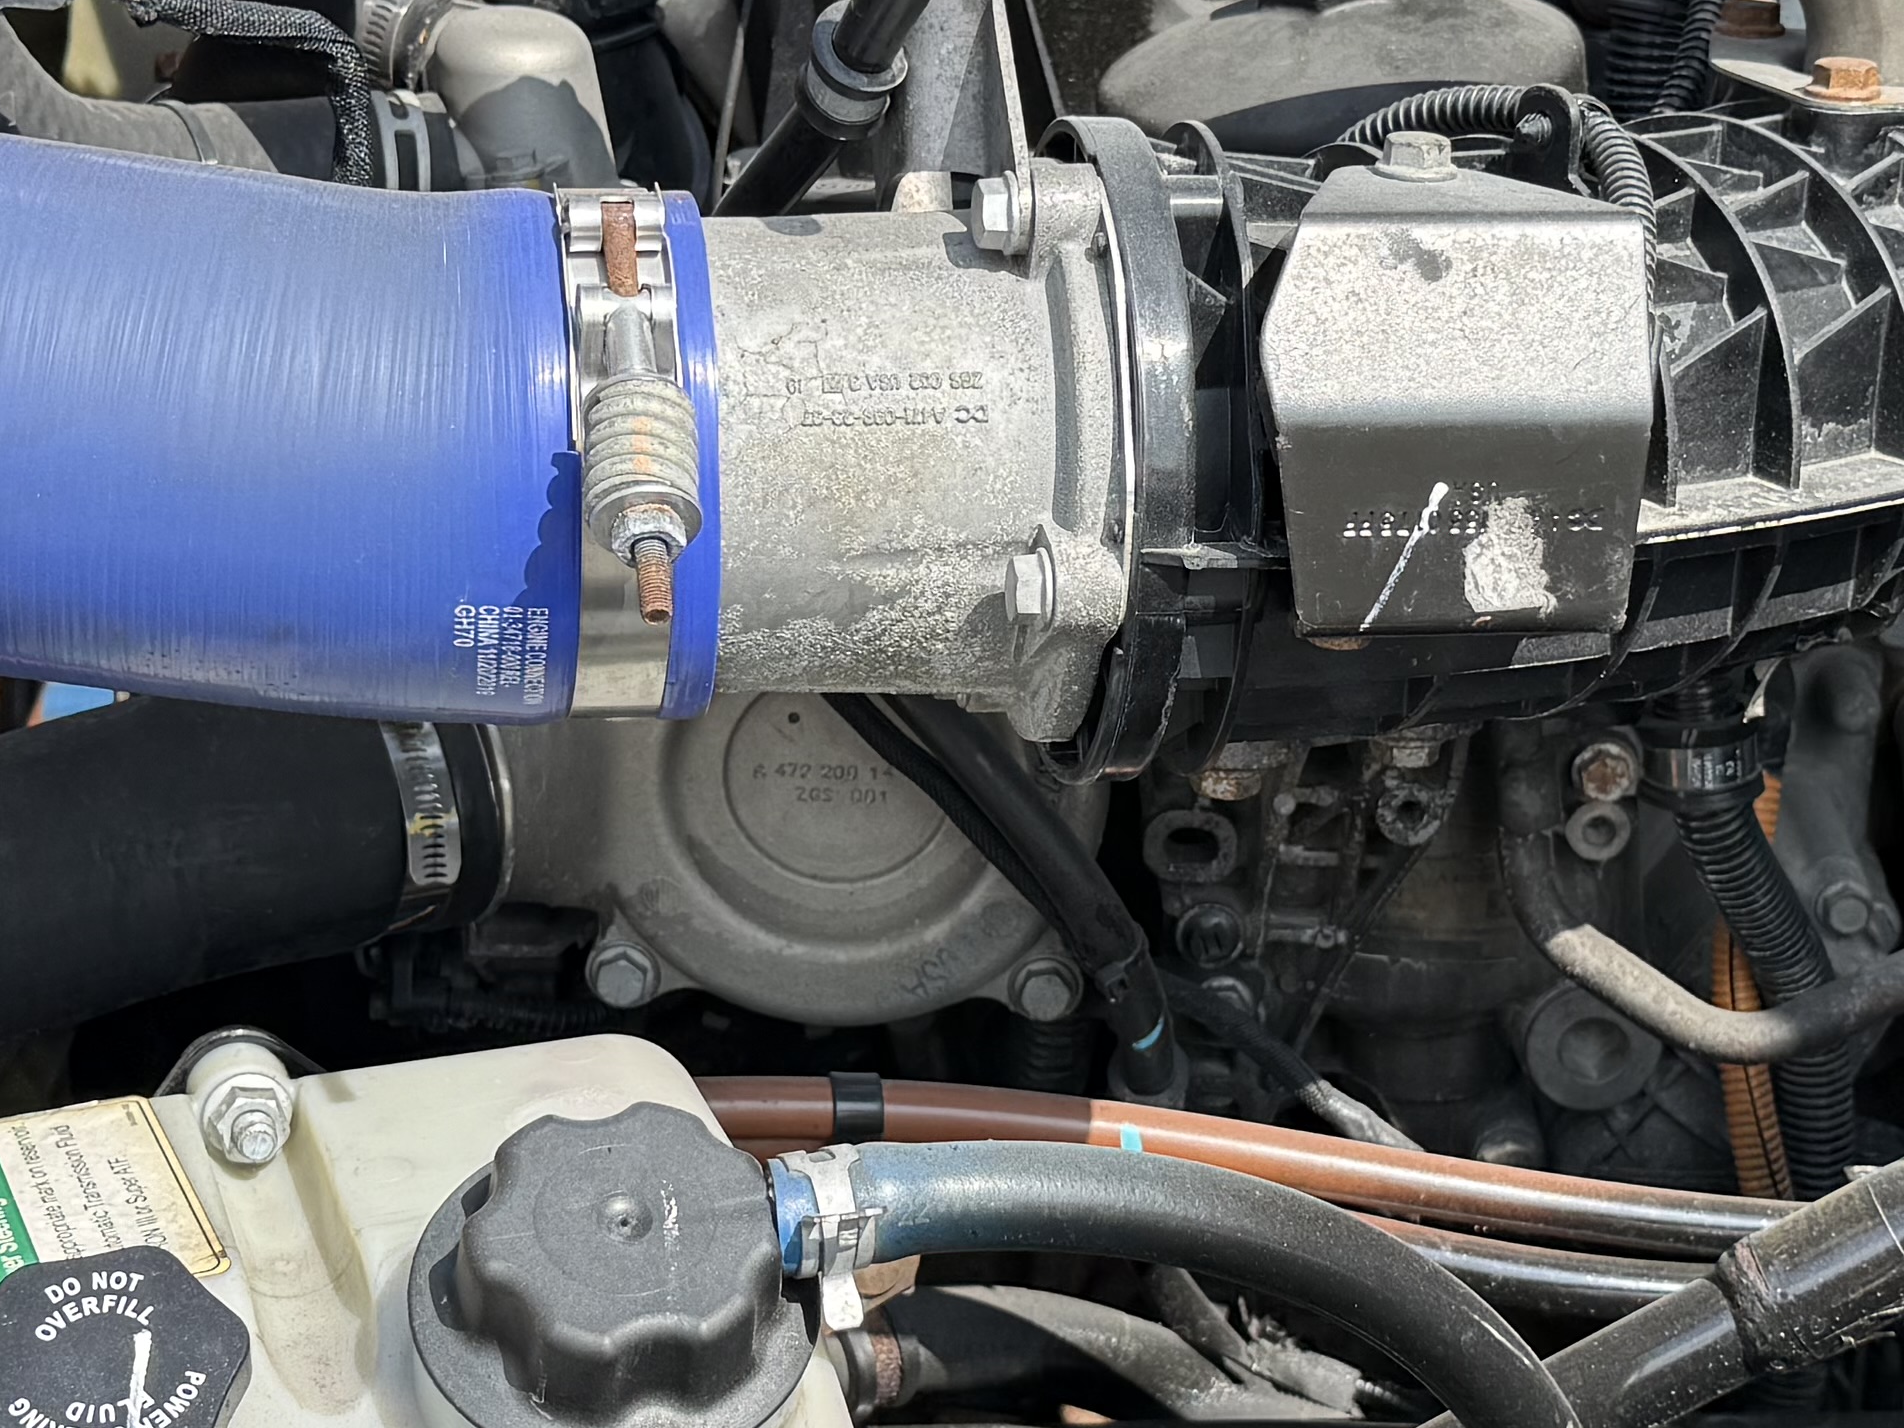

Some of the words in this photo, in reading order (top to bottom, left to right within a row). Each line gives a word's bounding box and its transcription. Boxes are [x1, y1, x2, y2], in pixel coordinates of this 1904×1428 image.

[453, 604, 476, 647] GH70
[477, 605, 500, 647] CHINA
[775, 762, 812, 779] 472
[49, 1124, 77, 1149] Fluid
[28, 1164, 48, 1179] on
[64, 1149, 103, 1211] Transmission
[107, 1157, 133, 1179] ATF
[120, 1176, 149, 1206] Super
[44, 1275, 82, 1305] DO
[92, 1270, 145, 1293] NOT
[34, 1293, 156, 1343] OVERFILL
[64, 1387, 156, 1424] FLUID
